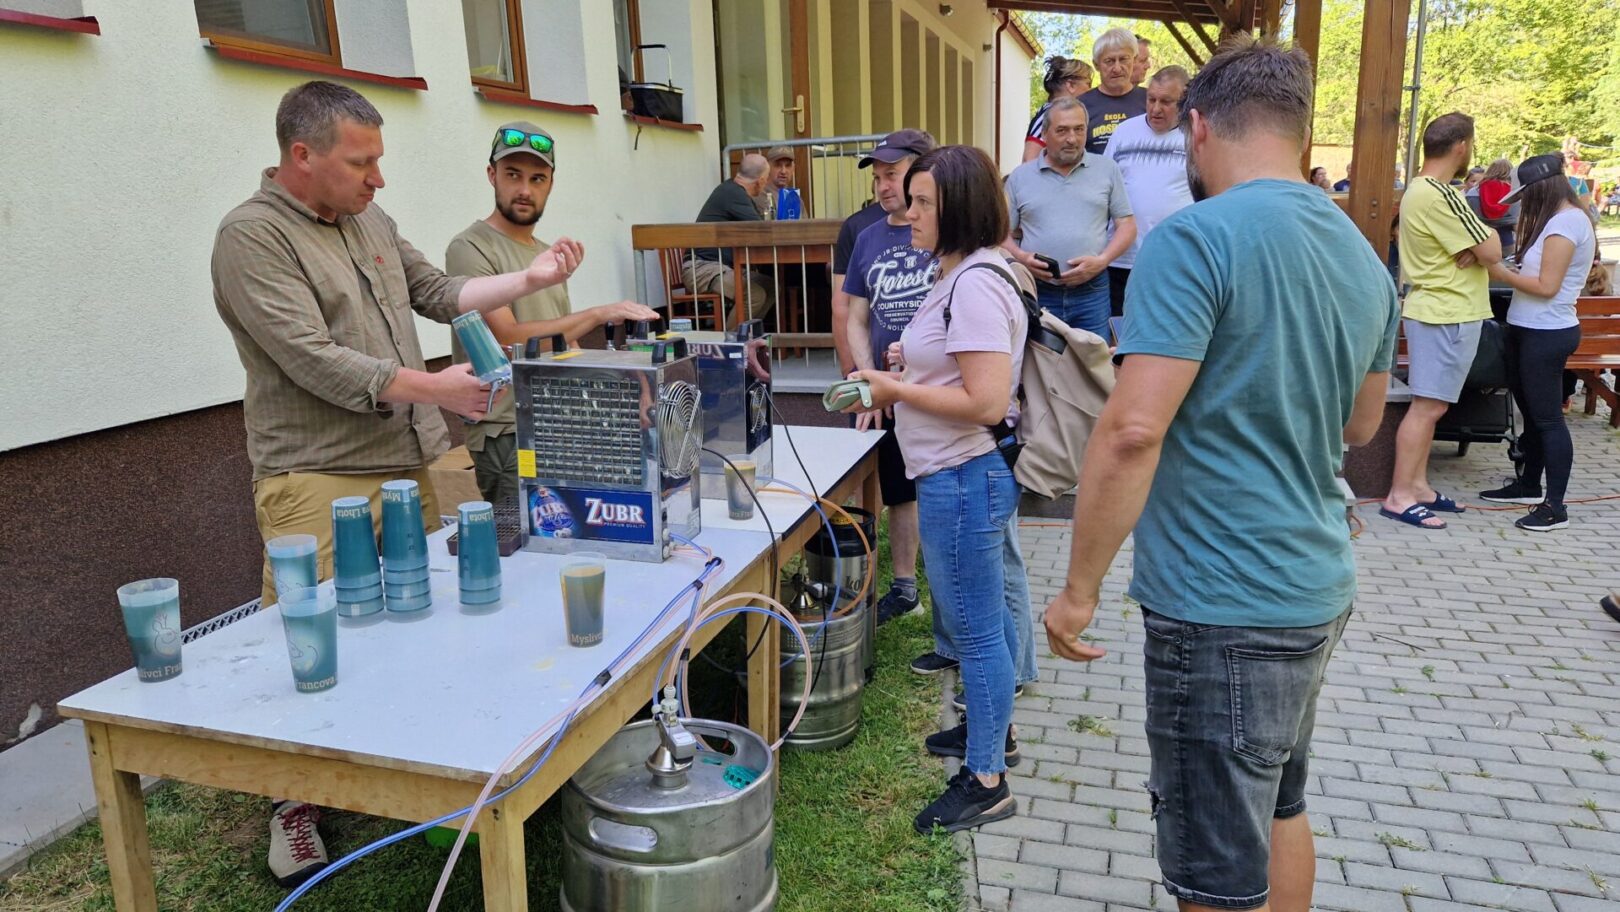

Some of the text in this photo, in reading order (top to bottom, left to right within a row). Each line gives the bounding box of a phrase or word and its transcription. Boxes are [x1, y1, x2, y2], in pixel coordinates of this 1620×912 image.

[877, 300, 925, 310] COUNTRYSID
[585, 497, 647, 526] ZUBR
[296, 675, 336, 690] rancova
